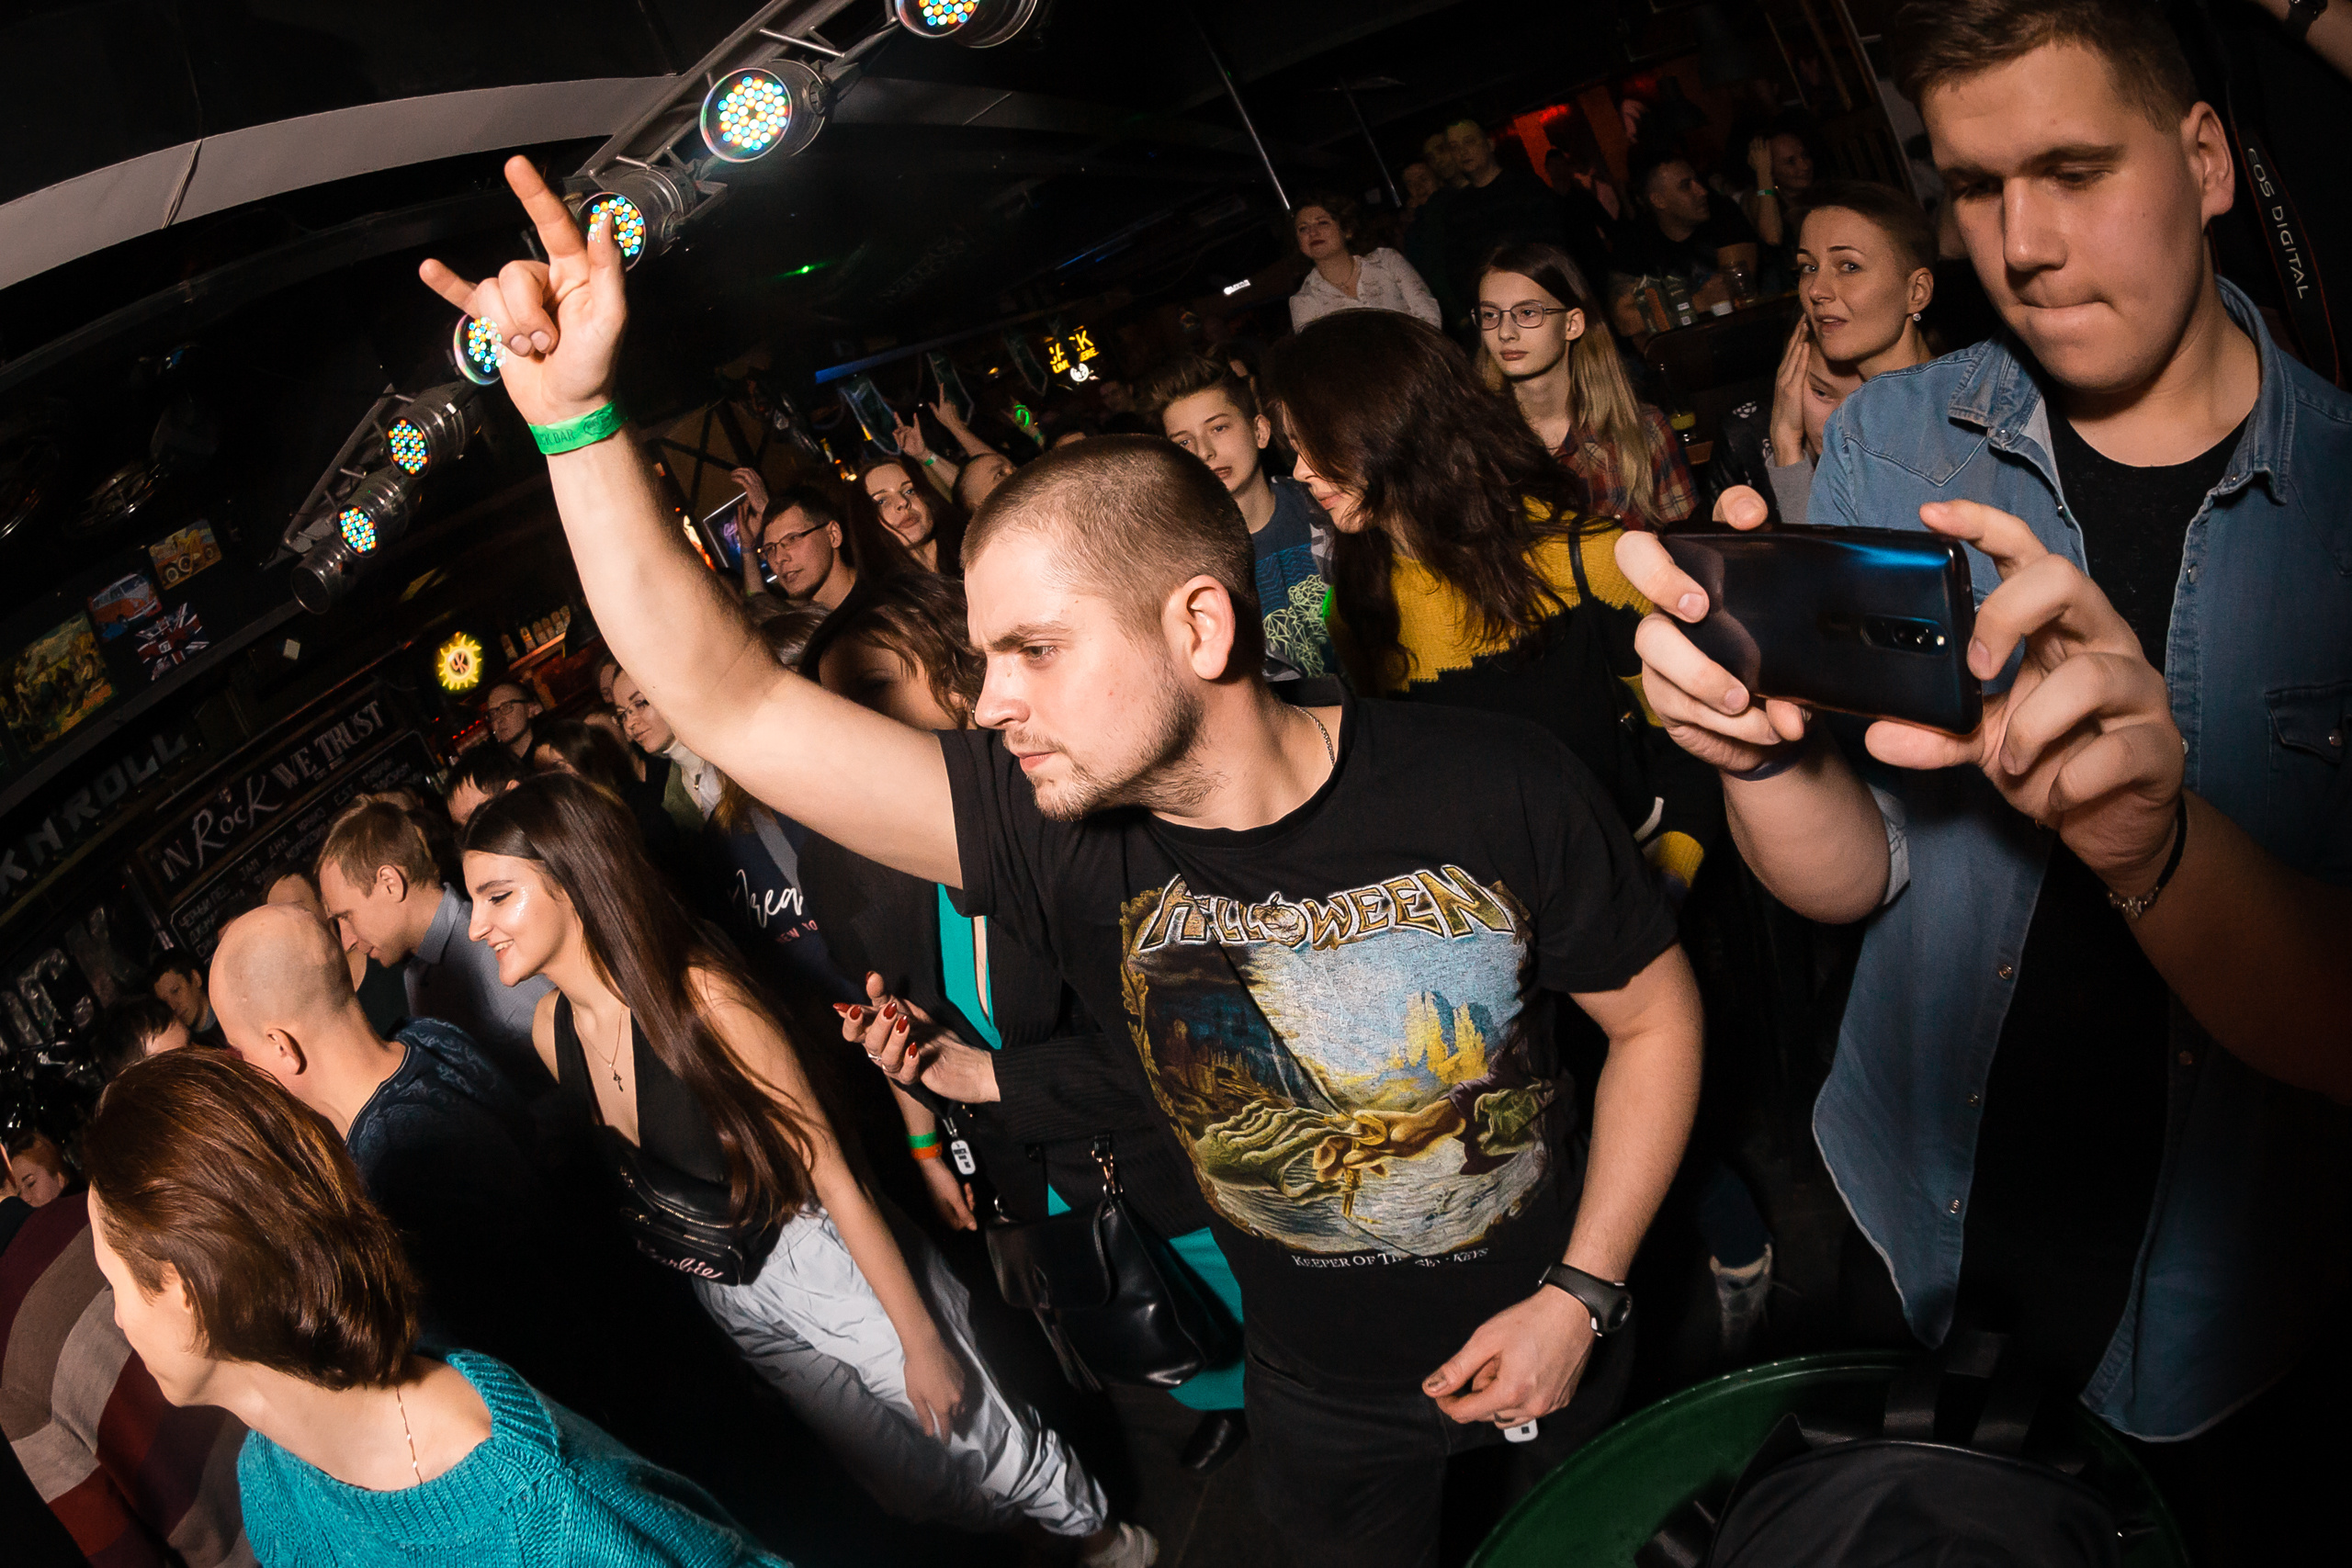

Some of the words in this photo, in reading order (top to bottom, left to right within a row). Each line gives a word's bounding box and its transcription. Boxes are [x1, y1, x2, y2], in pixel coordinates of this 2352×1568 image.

[2247, 147, 2275, 197] EOS
[2271, 205, 2310, 299] DIGITAL
[270, 746, 319, 790] WE
[313, 700, 385, 763] TRUST
[1292, 1254, 1352, 1269] KEEPER
[1351, 1254, 1376, 1267] OF
